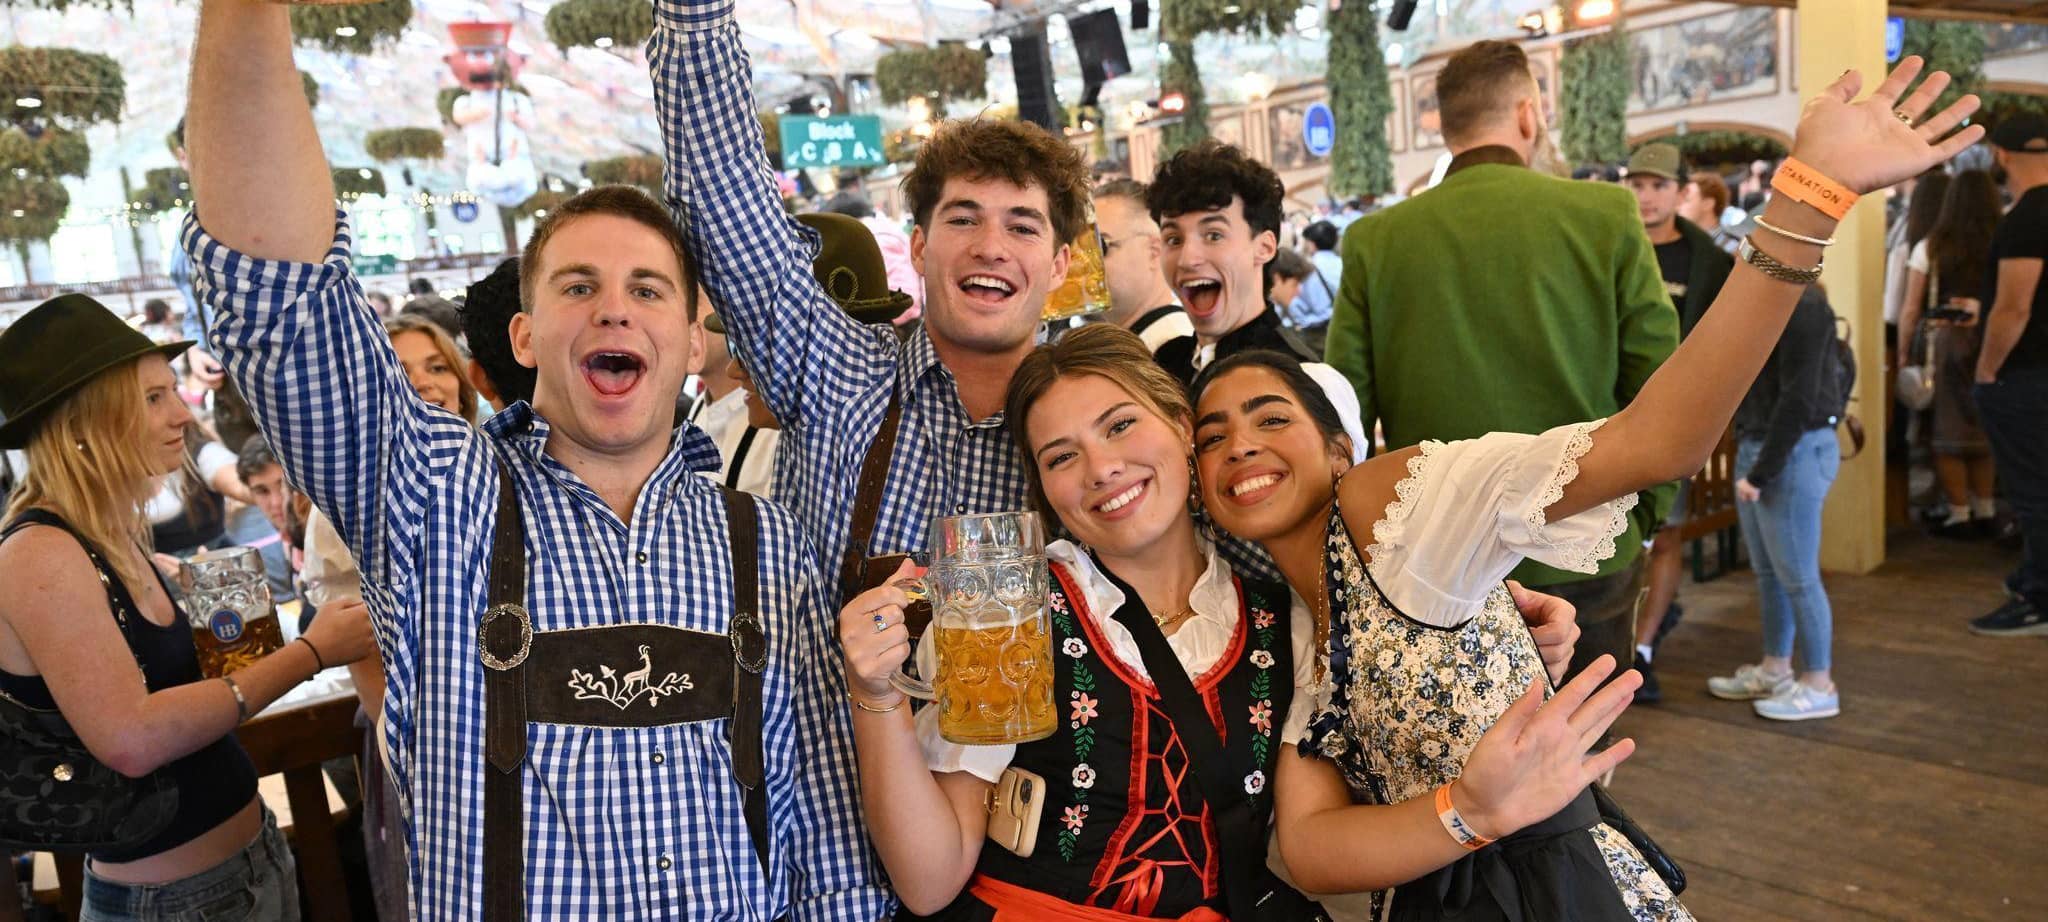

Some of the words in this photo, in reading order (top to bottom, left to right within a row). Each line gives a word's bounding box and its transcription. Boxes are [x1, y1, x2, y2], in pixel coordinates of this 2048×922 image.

[808, 121, 856, 140] Block
[801, 141, 817, 161] C
[853, 141, 867, 160] A
[219, 623, 238, 638] HB
